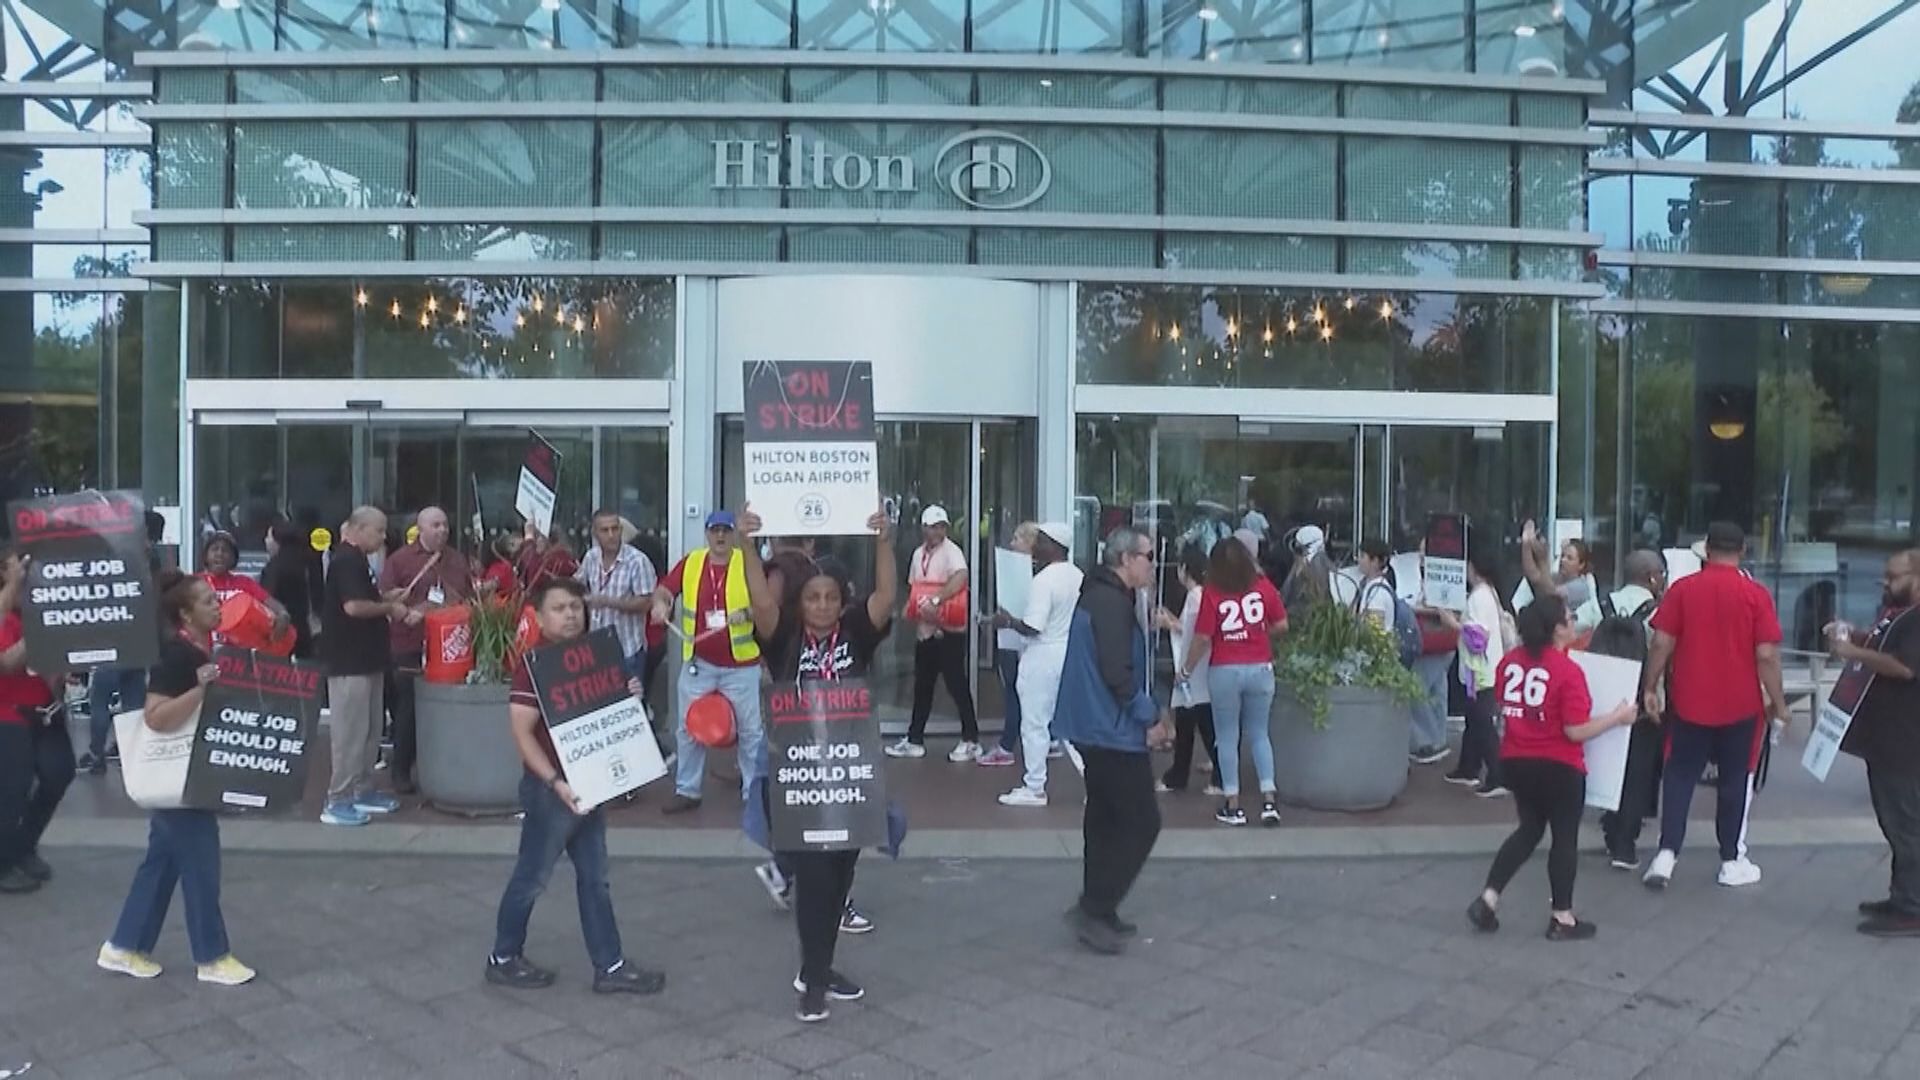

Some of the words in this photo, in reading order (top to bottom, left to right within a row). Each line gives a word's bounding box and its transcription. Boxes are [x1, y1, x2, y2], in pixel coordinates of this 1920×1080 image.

[710, 134, 919, 191] Hilton
[788, 369, 830, 397] ON
[759, 401, 862, 431] STRIKE
[752, 450, 805, 465] HILTON
[809, 450, 870, 464] BOSTON
[752, 471, 804, 485] LOGAN
[808, 470, 871, 483] AIRPORT
[16, 509, 47, 531] ON
[53, 501, 132, 528] STRIKE
[804, 504, 823, 516] 26
[42, 561, 83, 579] ONE
[87, 559, 125, 576] JOB
[31, 584, 109, 604] SHOULD
[112, 581, 141, 598] BE
[42, 605, 134, 627] ENOUGH.
[1218, 591, 1265, 632] 26
[563, 643, 594, 672] ON
[217, 655, 245, 673] ON
[251, 660, 320, 689] STRIKE
[550, 665, 625, 712] STRIKE
[1503, 663, 1550, 708] 26
[771, 693, 796, 711] ON
[800, 688, 870, 711] STRIKE
[220, 707, 260, 727] ONE
[263, 714, 298, 732] JOB
[559, 718, 600, 745] HILTON
[602, 705, 641, 730] BOSTON
[204, 727, 277, 750] SHOULD
[279, 739, 305, 755] BE
[566, 740, 605, 763] LOGAN
[606, 721, 645, 748] AIRPORT
[787, 745, 821, 761] ONE
[826, 743, 860, 760] JOB
[209, 750, 291, 774] ENOUGH.
[778, 766, 845, 783] SHOULD
[849, 764, 874, 780] BE
[785, 787, 866, 805] ENOUGH.
